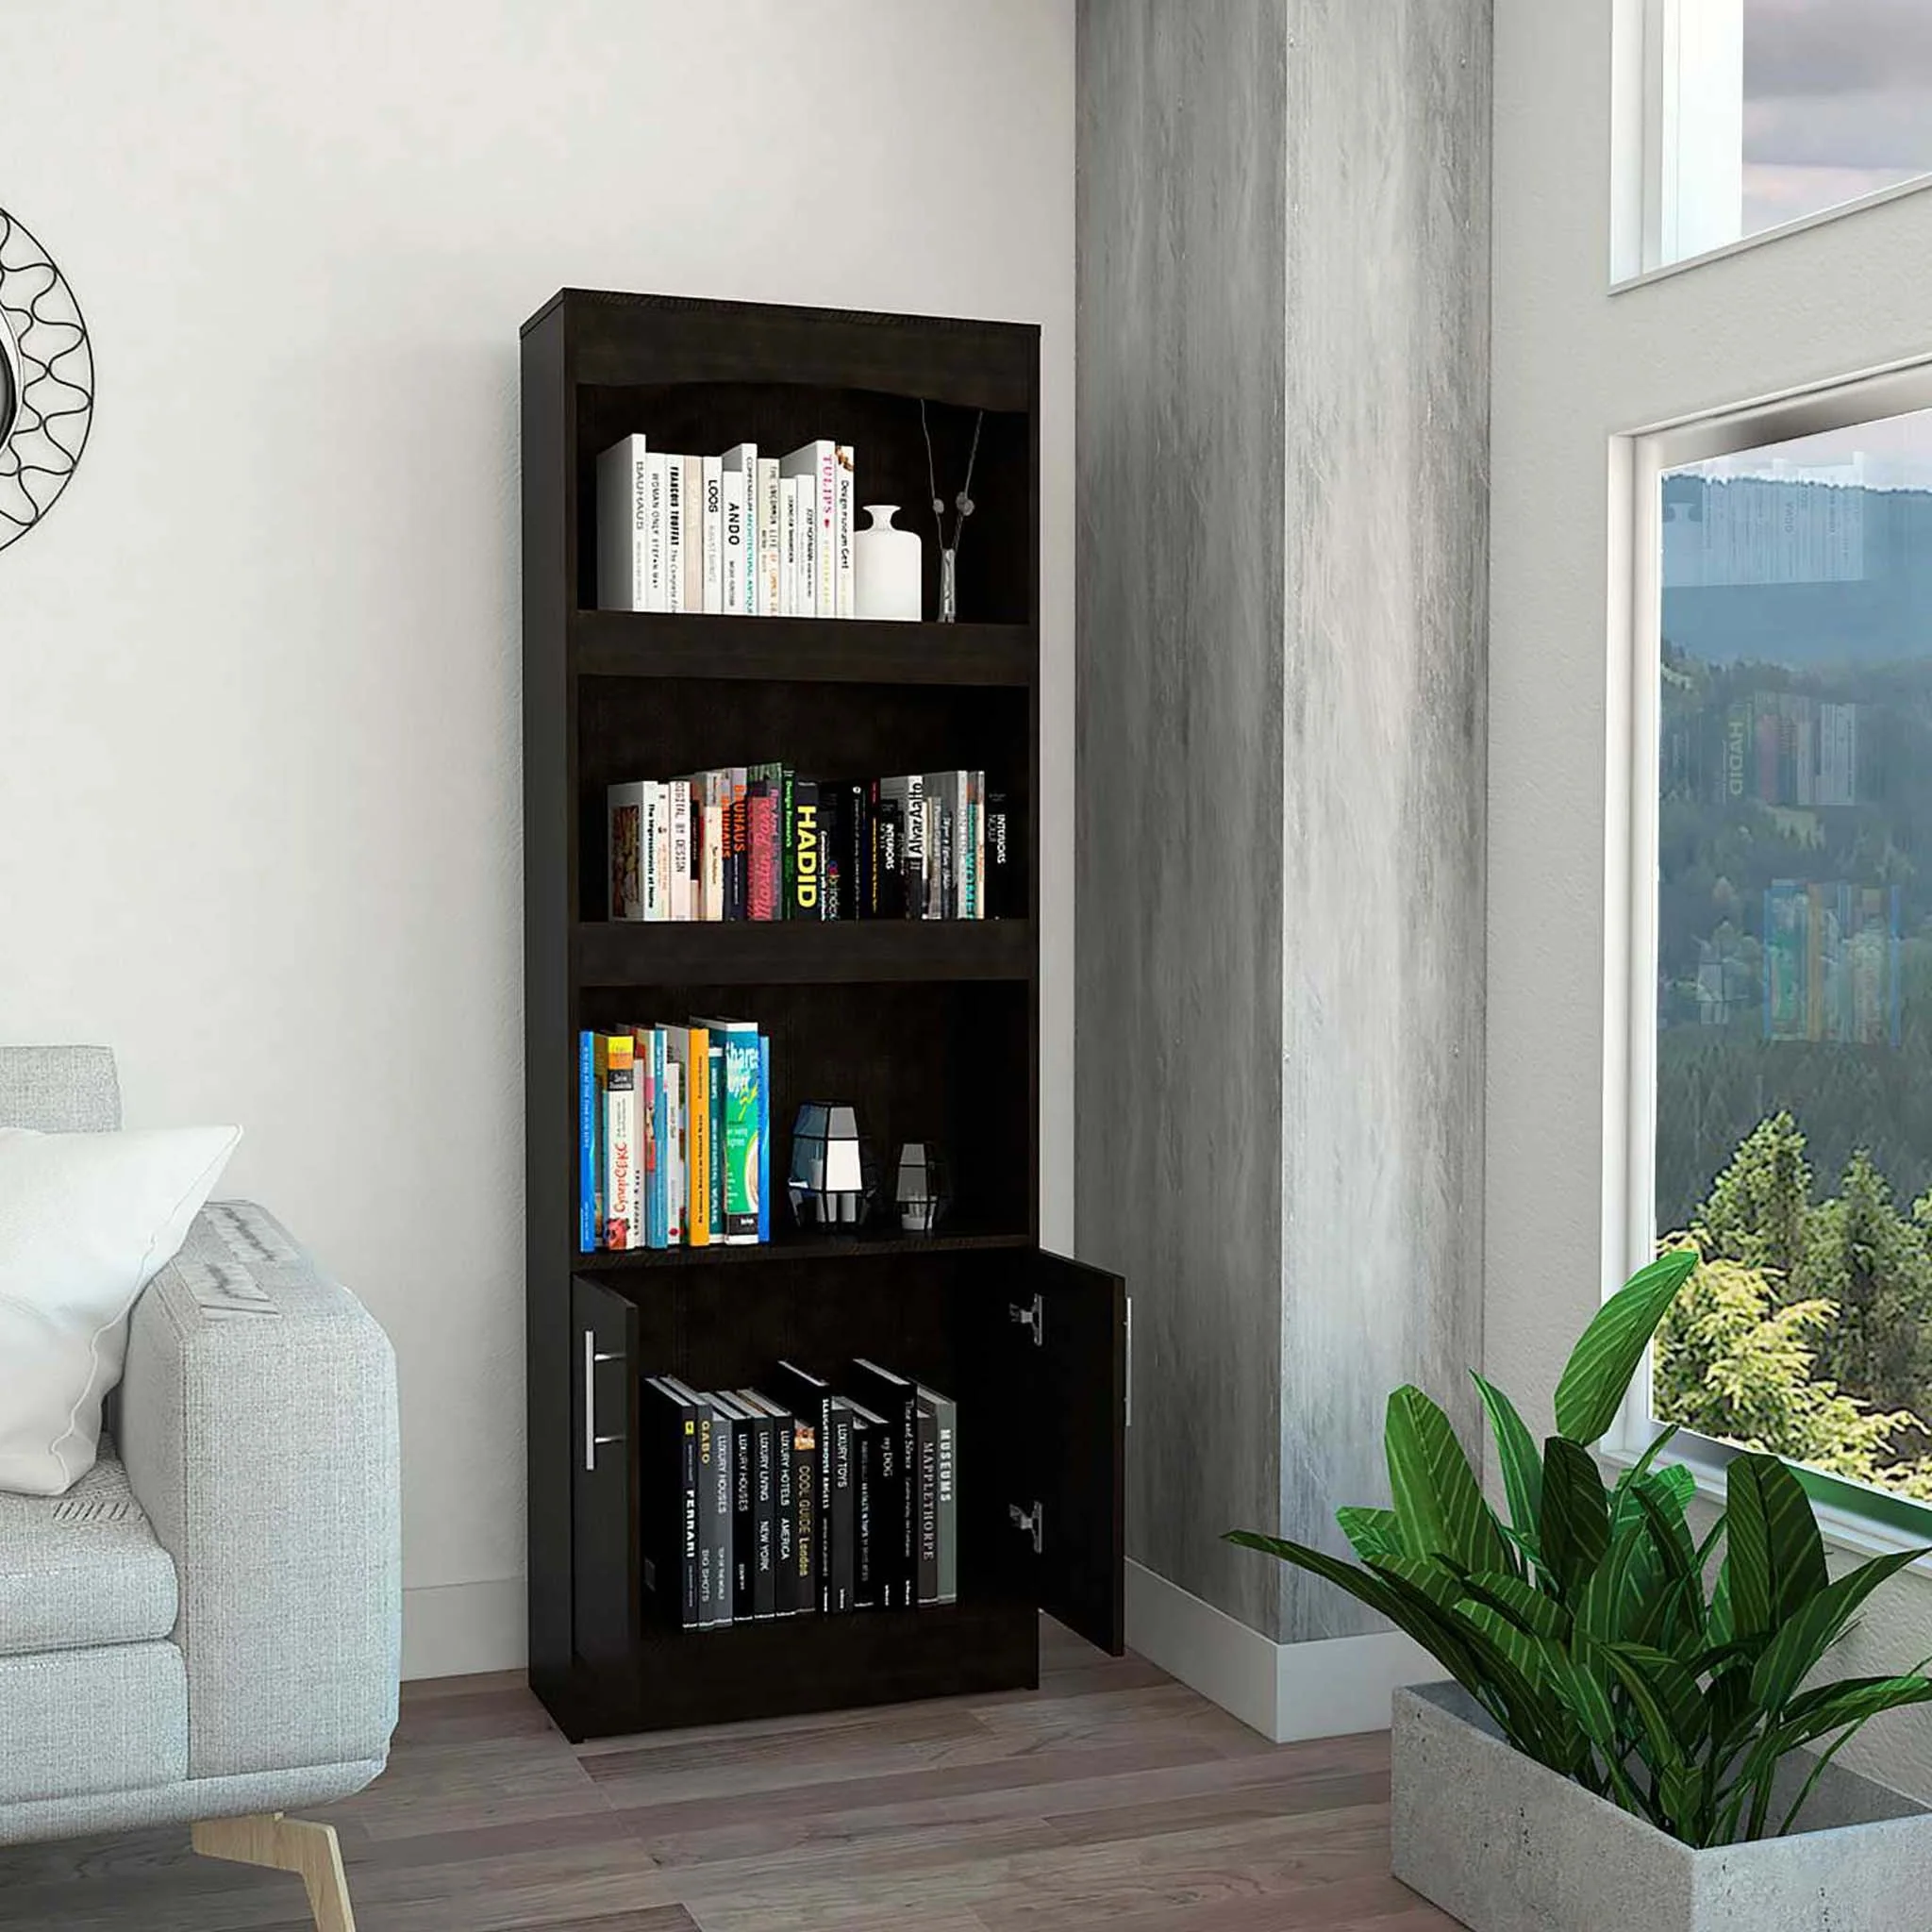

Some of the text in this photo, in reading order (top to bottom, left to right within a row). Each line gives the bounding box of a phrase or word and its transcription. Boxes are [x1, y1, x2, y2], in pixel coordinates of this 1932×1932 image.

[636, 461, 644, 530] BAUHAUS
[708, 480, 718, 513] LOOS
[824, 454, 832, 514] TULIPS
[841, 479, 849, 509] Design
[728, 503, 740, 546] ANDO
[675, 782, 686, 874] DIGITAL BY DESIGN
[734, 784, 745, 853] BAUHAUS
[997, 814, 1006, 864] INTERIORS
[797, 806, 816, 908] HADID
[885, 824, 894, 870] INTERIORS
[905, 1400, 914, 1422] Time
[905, 1423, 913, 1439] and
[702, 1421, 710, 1465] GABO
[717, 1435, 727, 1473] LUXURY
[739, 1434, 748, 1470] LUXURY
[837, 1423, 848, 1489] LUXURY TOYS
[883, 1452, 892, 1477] DOG
[940, 1428, 951, 1503] MUSEUMS
[717, 1474, 727, 1515] HOUSES
[739, 1472, 748, 1513] HOUSES
[758, 1431, 769, 1573] LUXURY LIVING NEW YORK
[780, 1429, 791, 1561] LUXURY HOTELS AMERICA
[923, 1441, 933, 1561] MAPPLETHORPE
[687, 1490, 695, 1558] FERRARI
[798, 1465, 810, 1577] COOL GUIDE London
